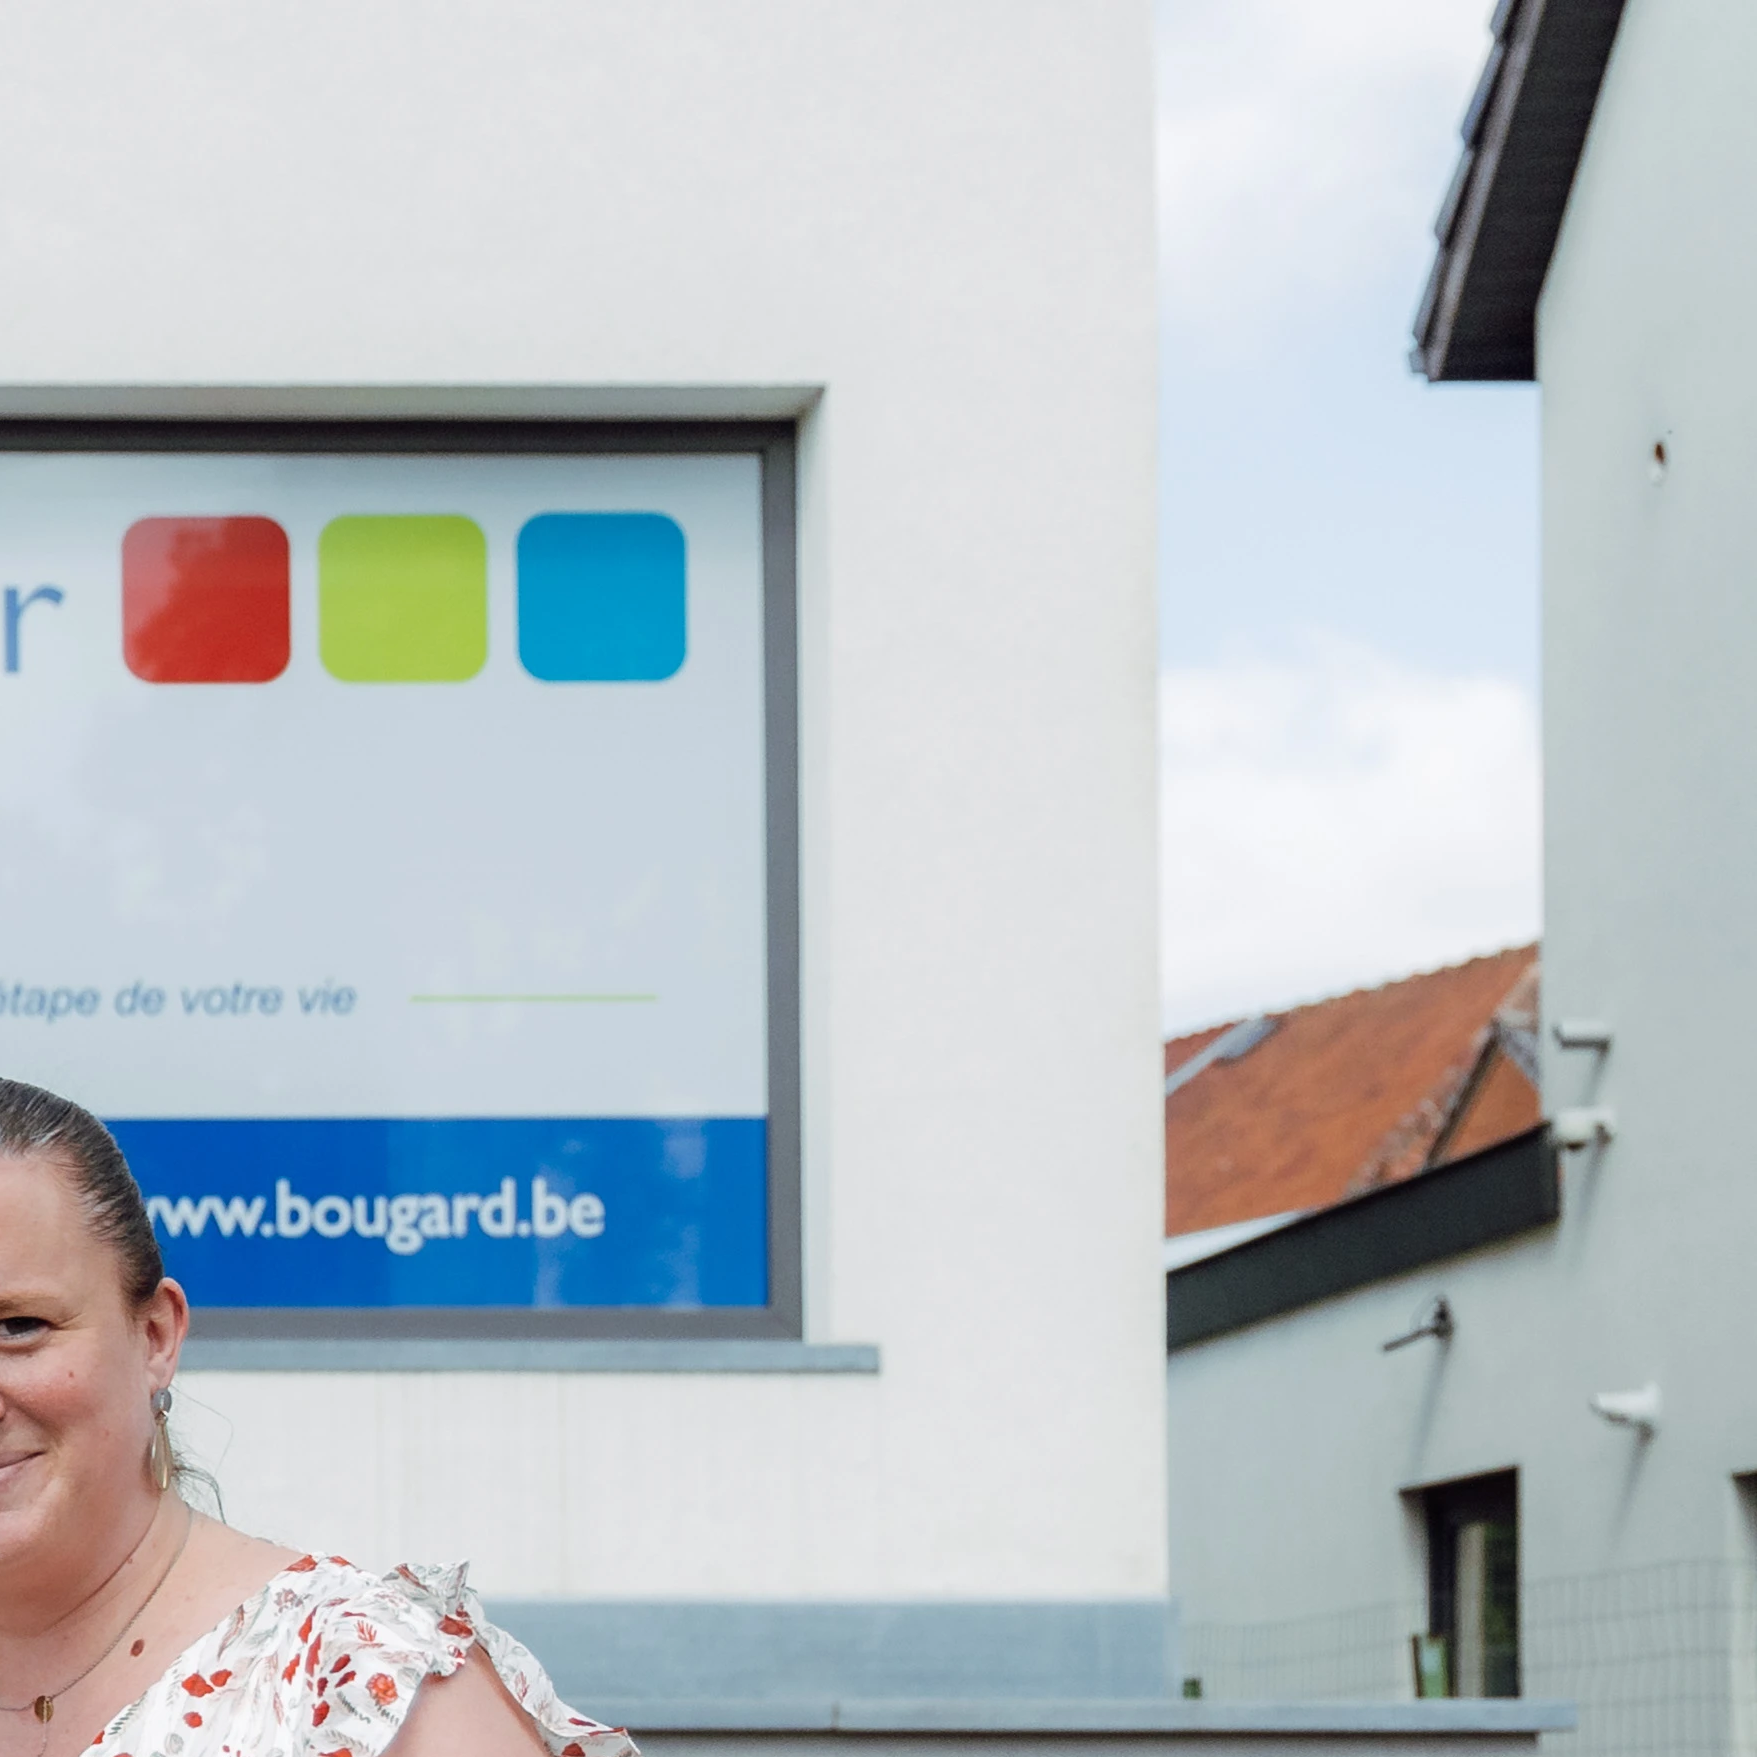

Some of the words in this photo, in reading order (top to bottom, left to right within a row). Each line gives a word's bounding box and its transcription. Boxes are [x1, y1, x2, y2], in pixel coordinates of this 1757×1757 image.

[113, 980, 167, 1018] de
[180, 981, 286, 1017] votre
[297, 979, 358, 1017] vie
[146, 1175, 606, 1255] ww.bougard.be
